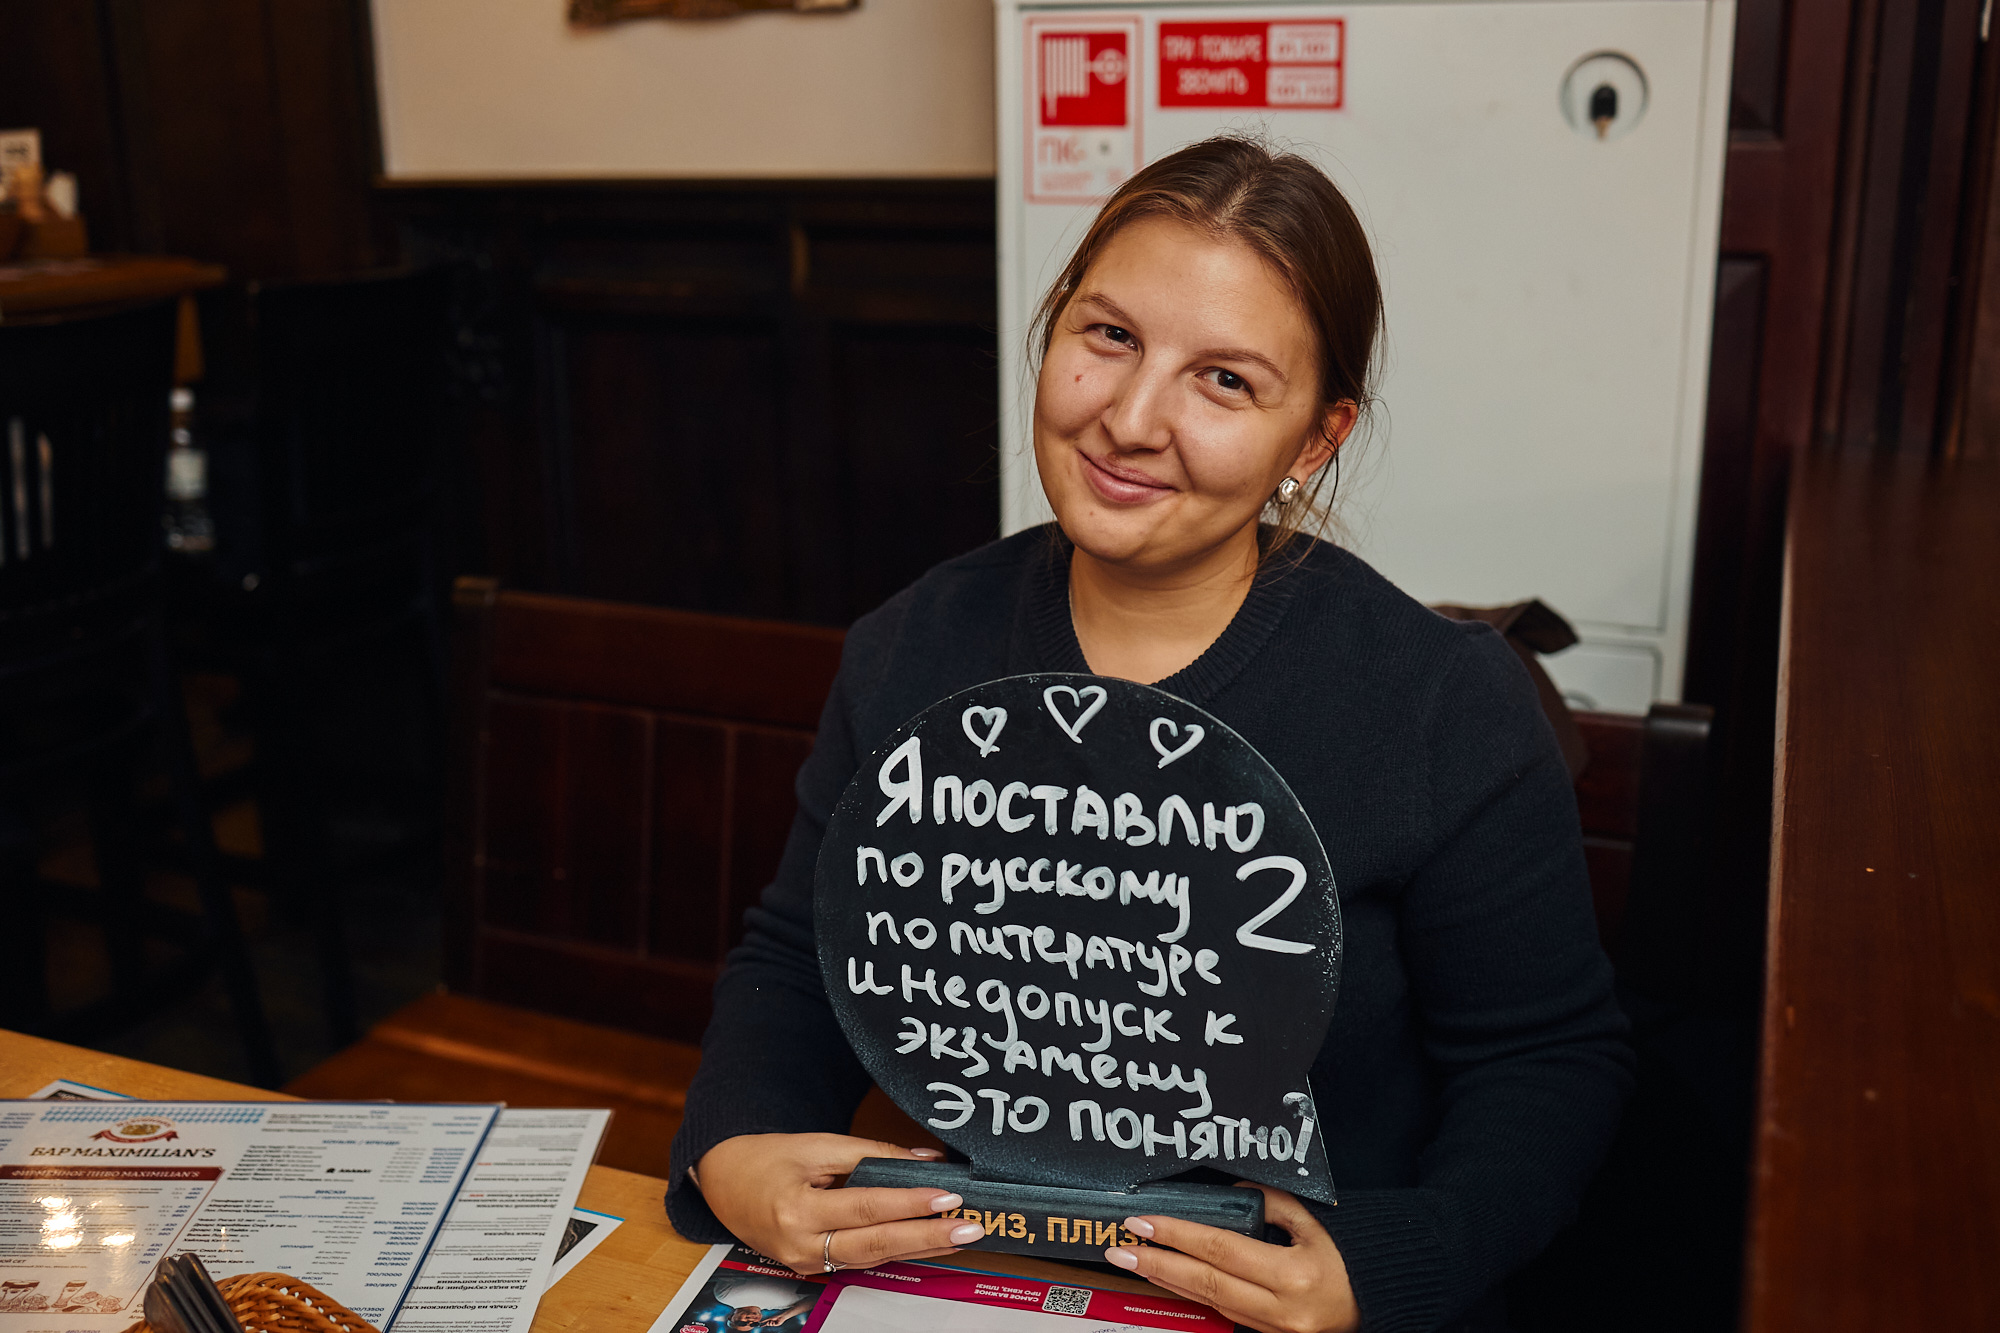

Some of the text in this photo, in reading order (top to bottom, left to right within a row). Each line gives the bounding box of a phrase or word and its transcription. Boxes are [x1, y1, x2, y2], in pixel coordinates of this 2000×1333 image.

[876, 736, 922, 827] Я
[941, 853, 1190, 942] русскому
[1235, 855, 1316, 954] 2
[29, 1147, 216, 1158] БАР MAXIMILIAN'S
[1047, 1216, 1148, 1248] ПЛИЗ
[747, 1265, 793, 1278] НОЯБРЯ
[864, 1270, 922, 1283] QUIZPLEASE.RU
[974, 1289, 1039, 1302] САМОЕ ВАЖНОЕ
[1023, 1289, 1042, 1297] ПРО
